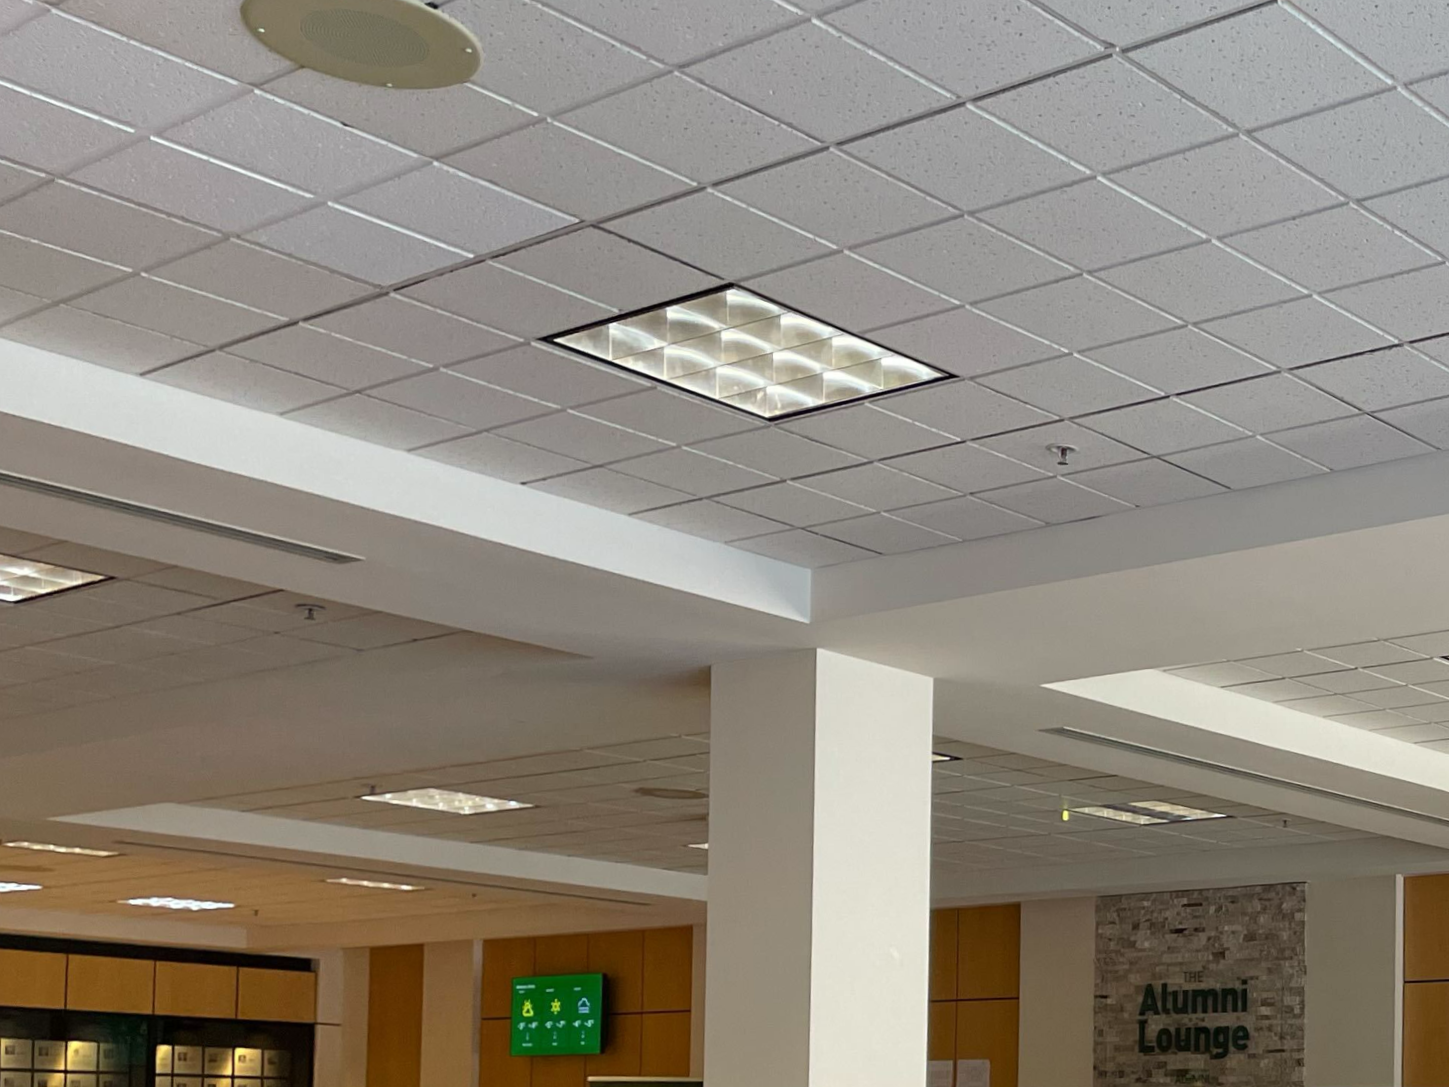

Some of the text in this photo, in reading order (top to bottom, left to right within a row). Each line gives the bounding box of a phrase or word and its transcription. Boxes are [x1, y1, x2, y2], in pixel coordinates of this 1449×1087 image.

[1183, 971, 1204, 983] THE
[1138, 979, 1248, 1016] Alumni
[1137, 1019, 1250, 1059] Lounge
